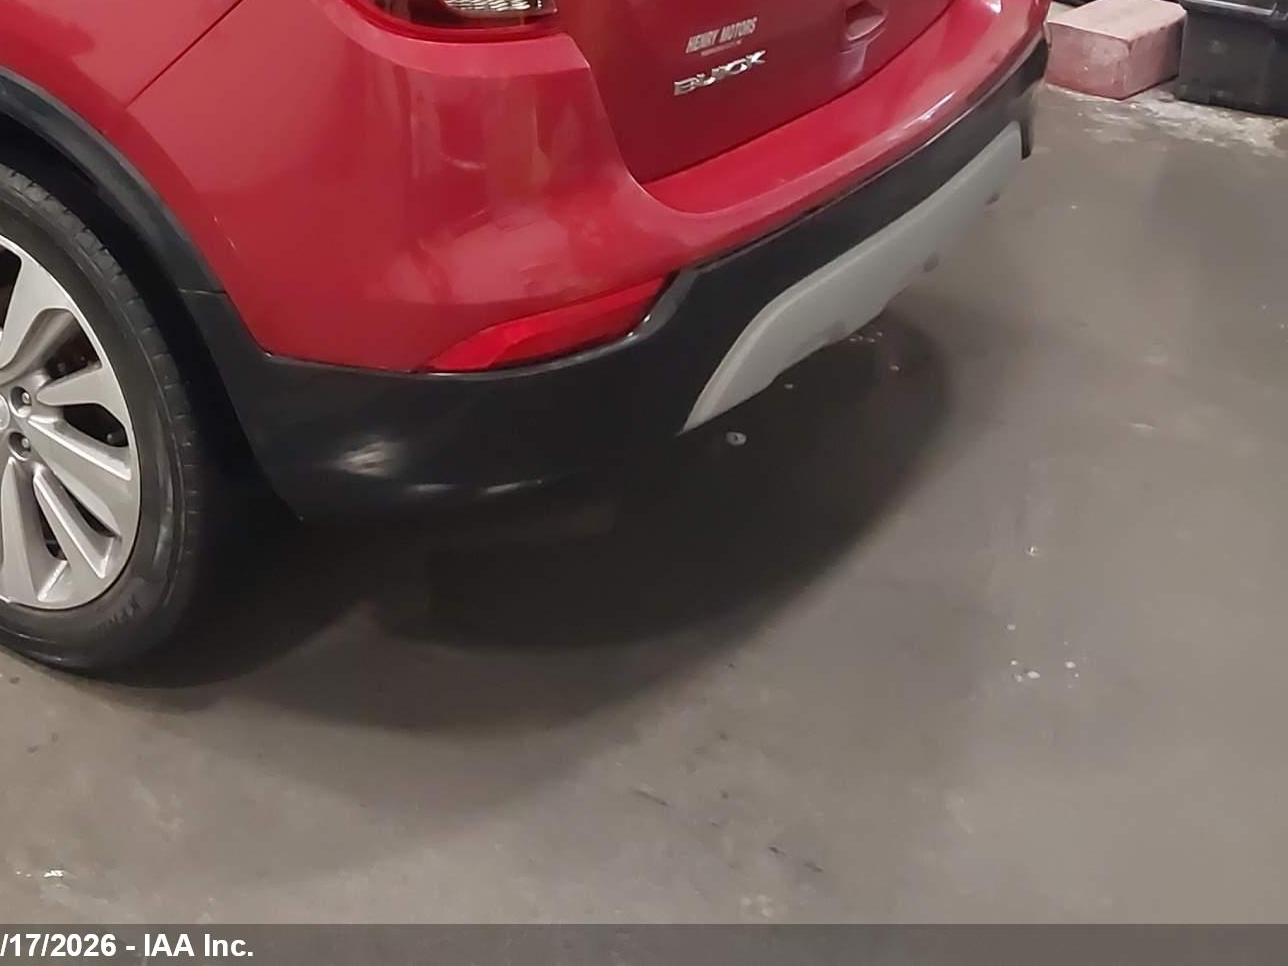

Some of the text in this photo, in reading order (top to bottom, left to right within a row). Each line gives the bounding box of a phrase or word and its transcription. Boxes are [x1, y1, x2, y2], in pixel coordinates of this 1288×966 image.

[685, 28, 721, 54] HENRY
[718, 17, 757, 43] MOTORS
[674, 50, 766, 96] BUICK
